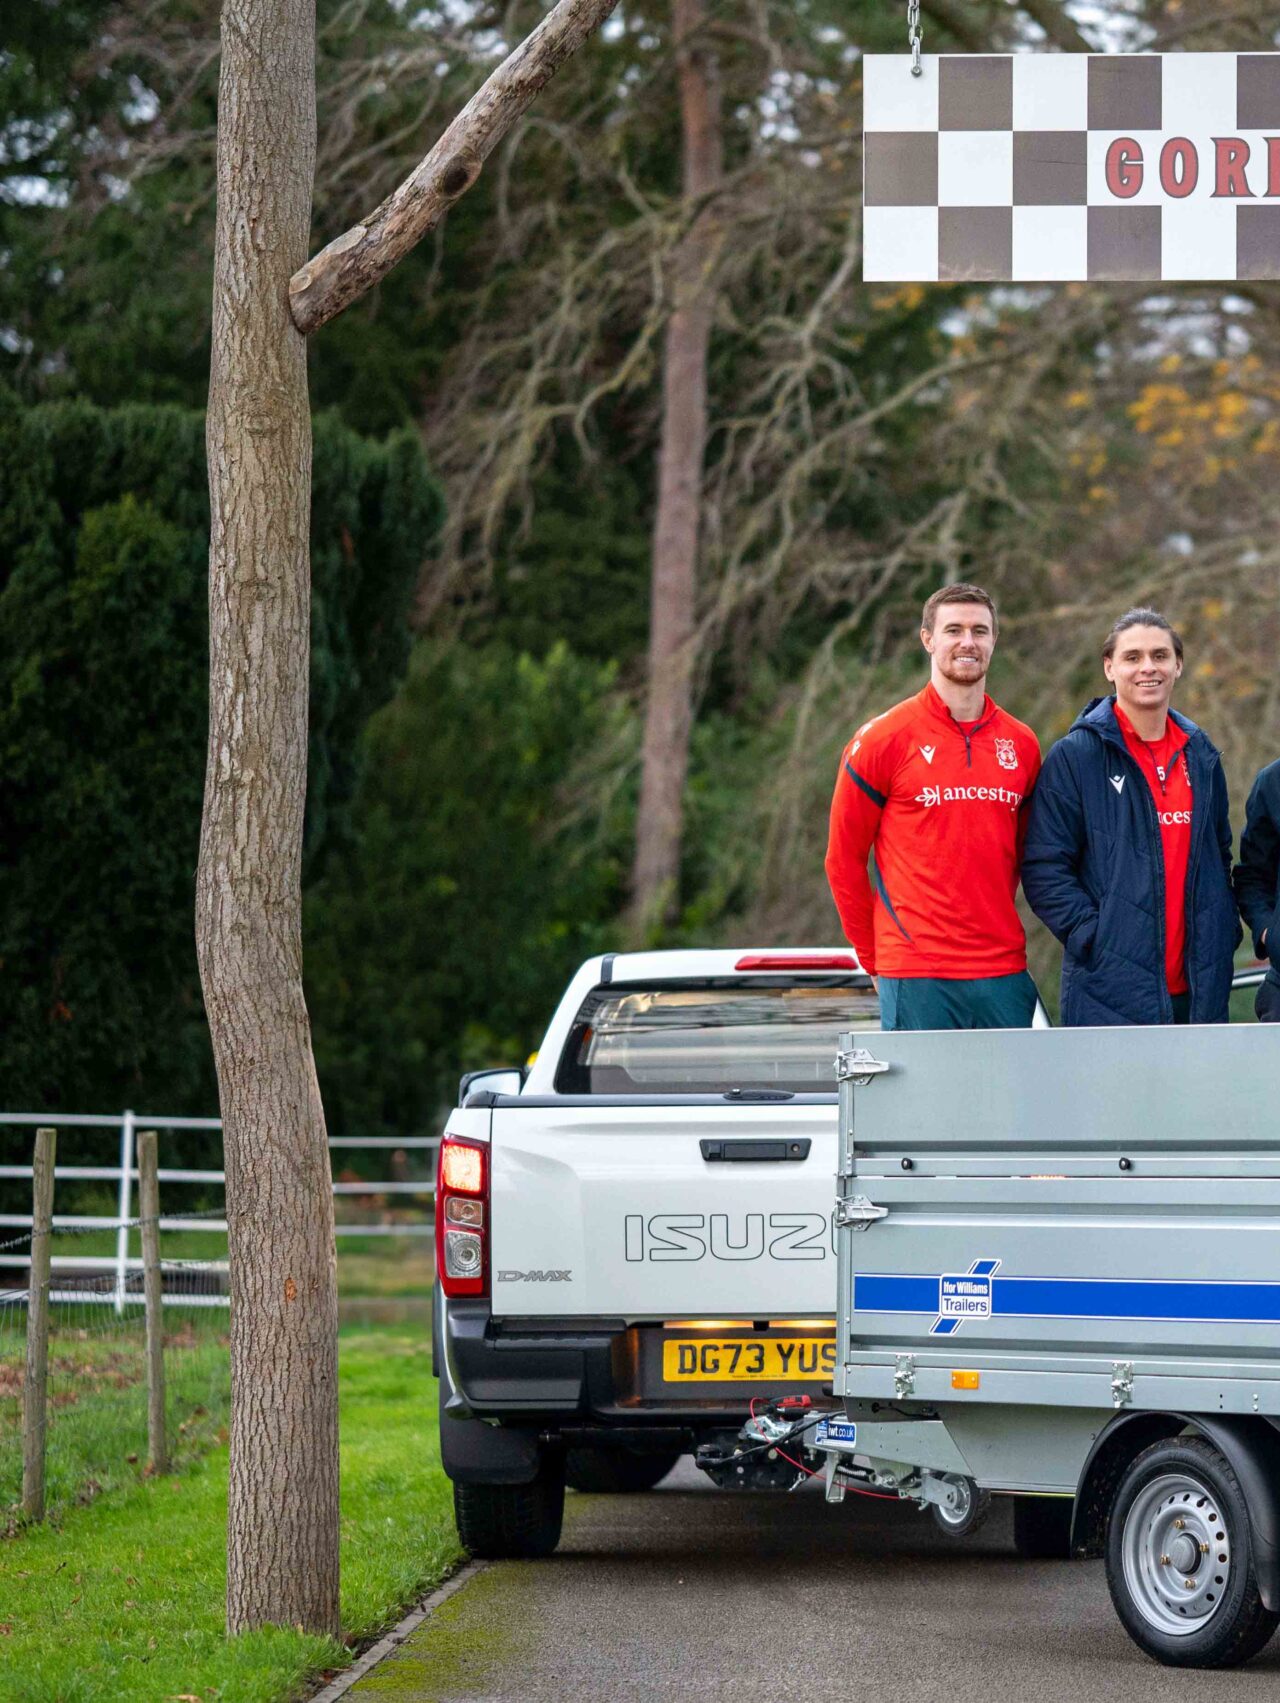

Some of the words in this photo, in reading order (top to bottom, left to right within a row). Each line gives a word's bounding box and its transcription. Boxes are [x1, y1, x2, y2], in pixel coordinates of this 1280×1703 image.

[943, 785, 1022, 812] ancestry
[625, 1213, 838, 1262] ISUZ
[956, 1281, 988, 1295] Williams
[944, 1297, 988, 1312] Trailers
[677, 1343, 765, 1375] DG73
[776, 1342, 837, 1374] YUS
